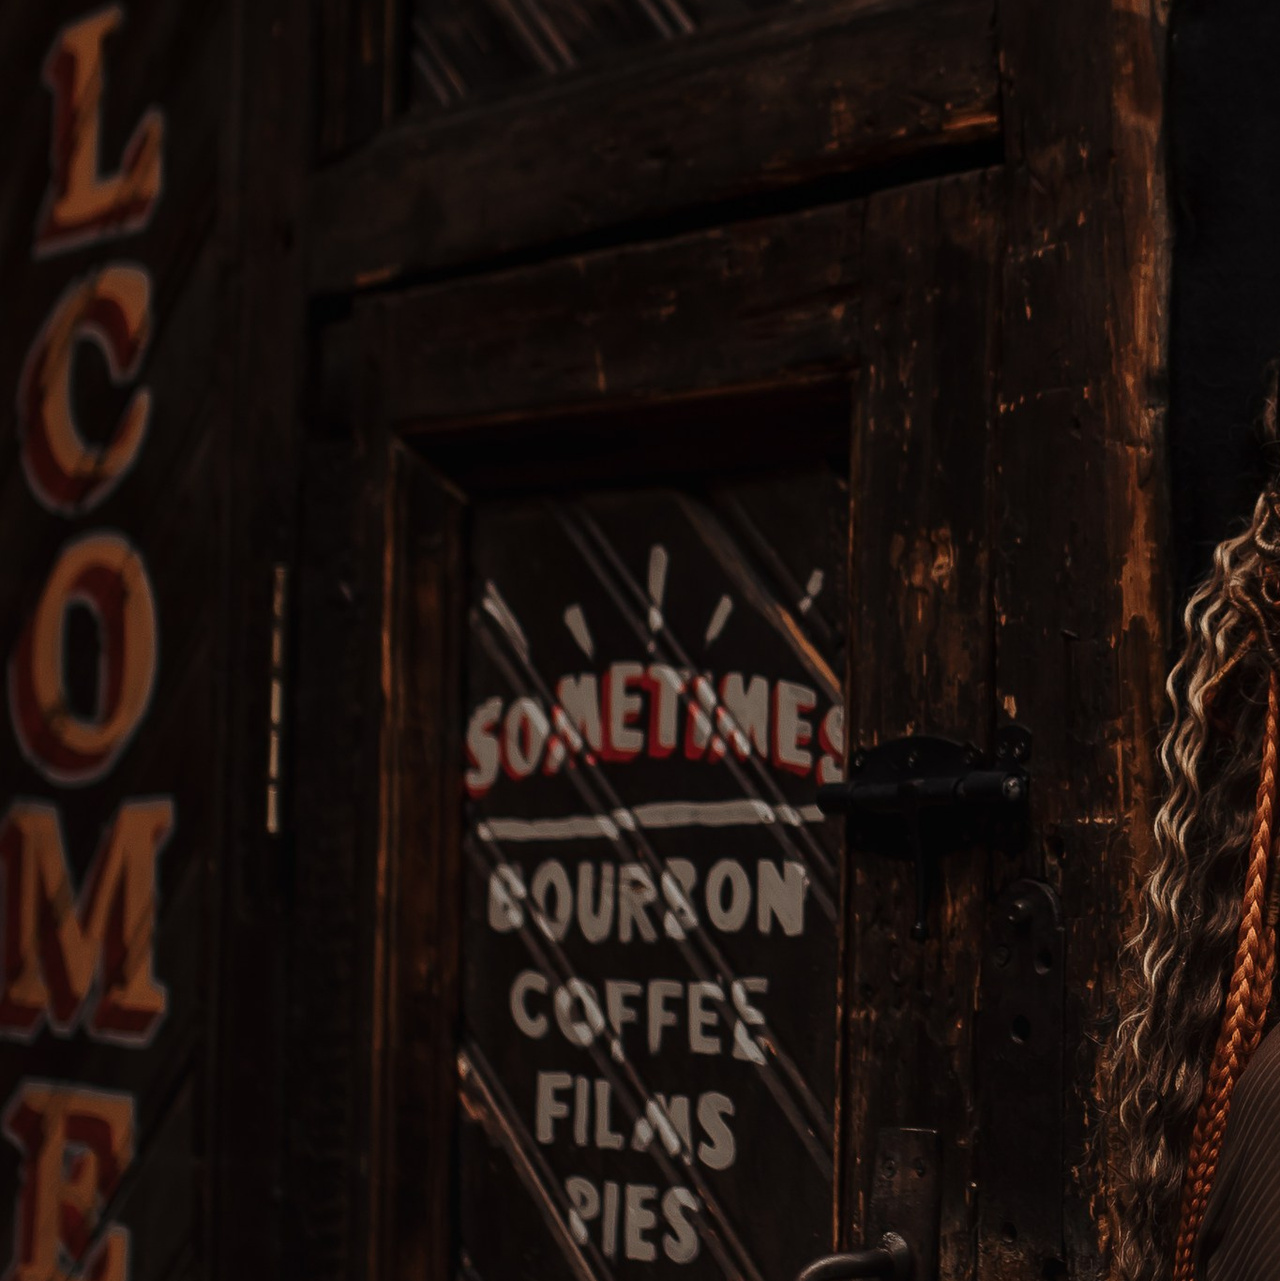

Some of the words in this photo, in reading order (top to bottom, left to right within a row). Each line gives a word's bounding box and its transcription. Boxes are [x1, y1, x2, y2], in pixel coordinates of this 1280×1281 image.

[488, 857, 809, 945] BOURBON
[509, 969, 770, 1065] COFFEE
[535, 1071, 736, 1170] FILMS
[564, 1176, 701, 1265] PIES
